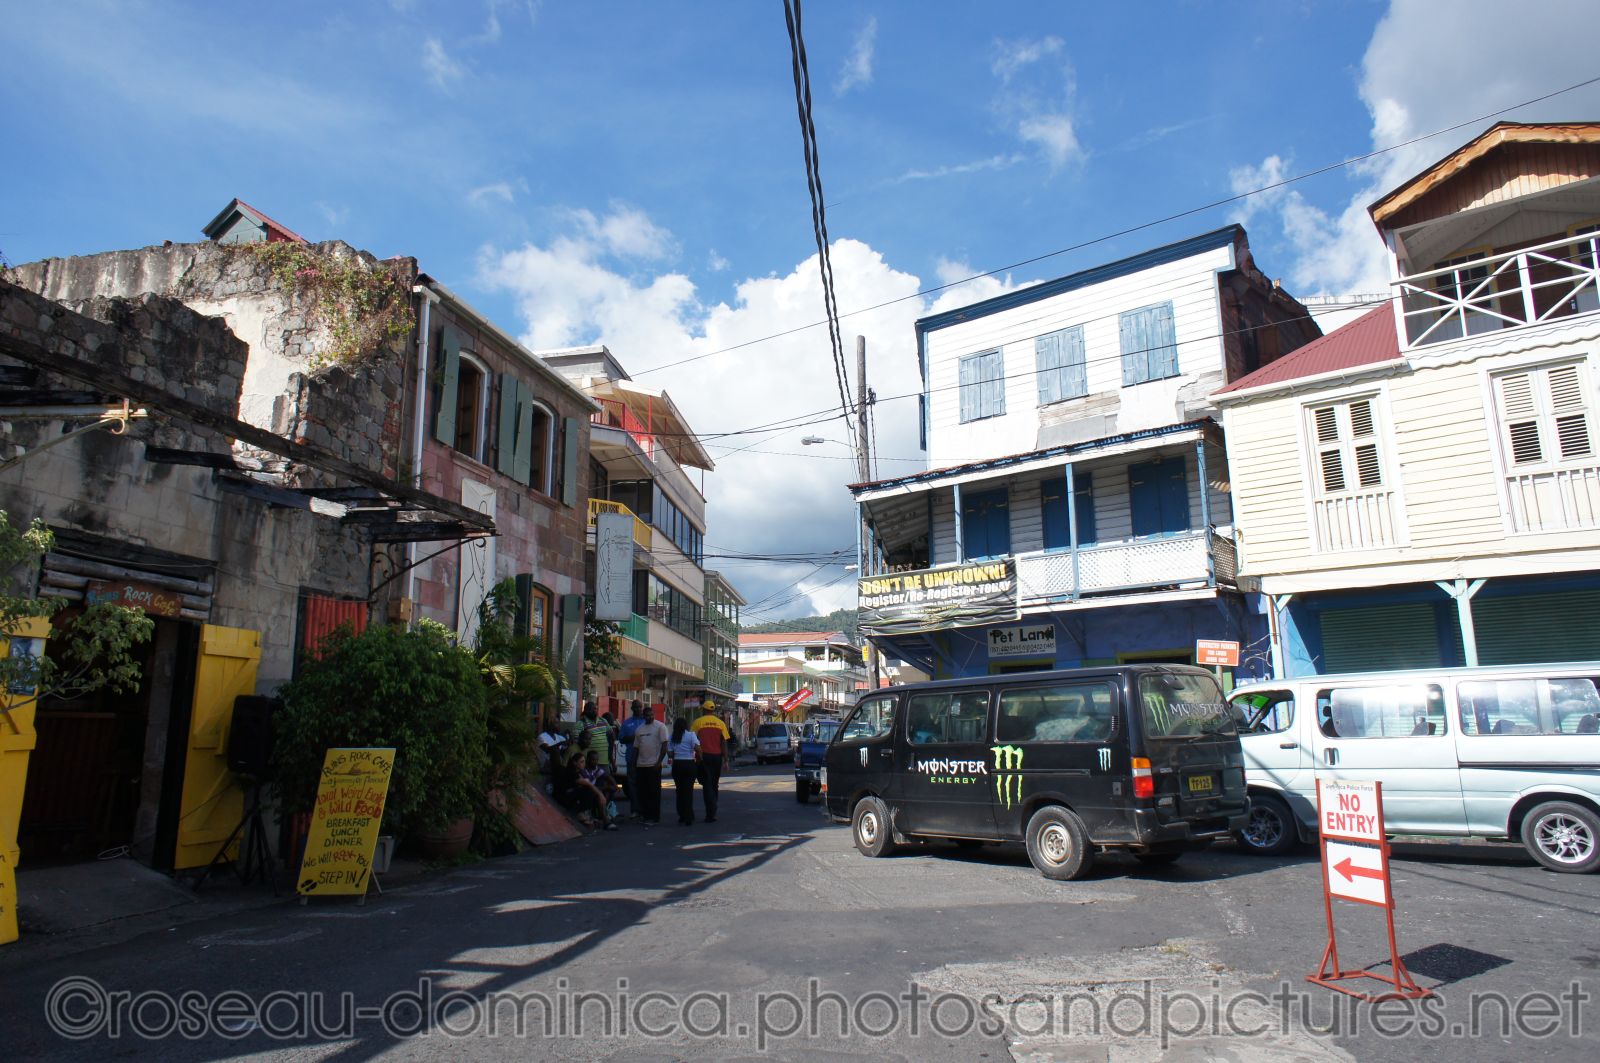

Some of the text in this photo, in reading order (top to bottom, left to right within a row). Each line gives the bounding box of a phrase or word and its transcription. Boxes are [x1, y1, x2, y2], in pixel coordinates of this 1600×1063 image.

[862, 563, 1007, 595] DON'T BE UNKNOWN!
[990, 625, 1055, 644] Pet Land
[350, 751, 372, 763] ROCK
[917, 757, 988, 775] MONSTER
[930, 776, 977, 784] ENERGY
[1338, 793, 1361, 812] NO
[326, 818, 371, 828] BREAKFAST
[1327, 811, 1376, 834] ENTRY
[331, 828, 360, 837] LUNCH
[324, 838, 363, 847] DINNER
[318, 871, 344, 885] STEP
